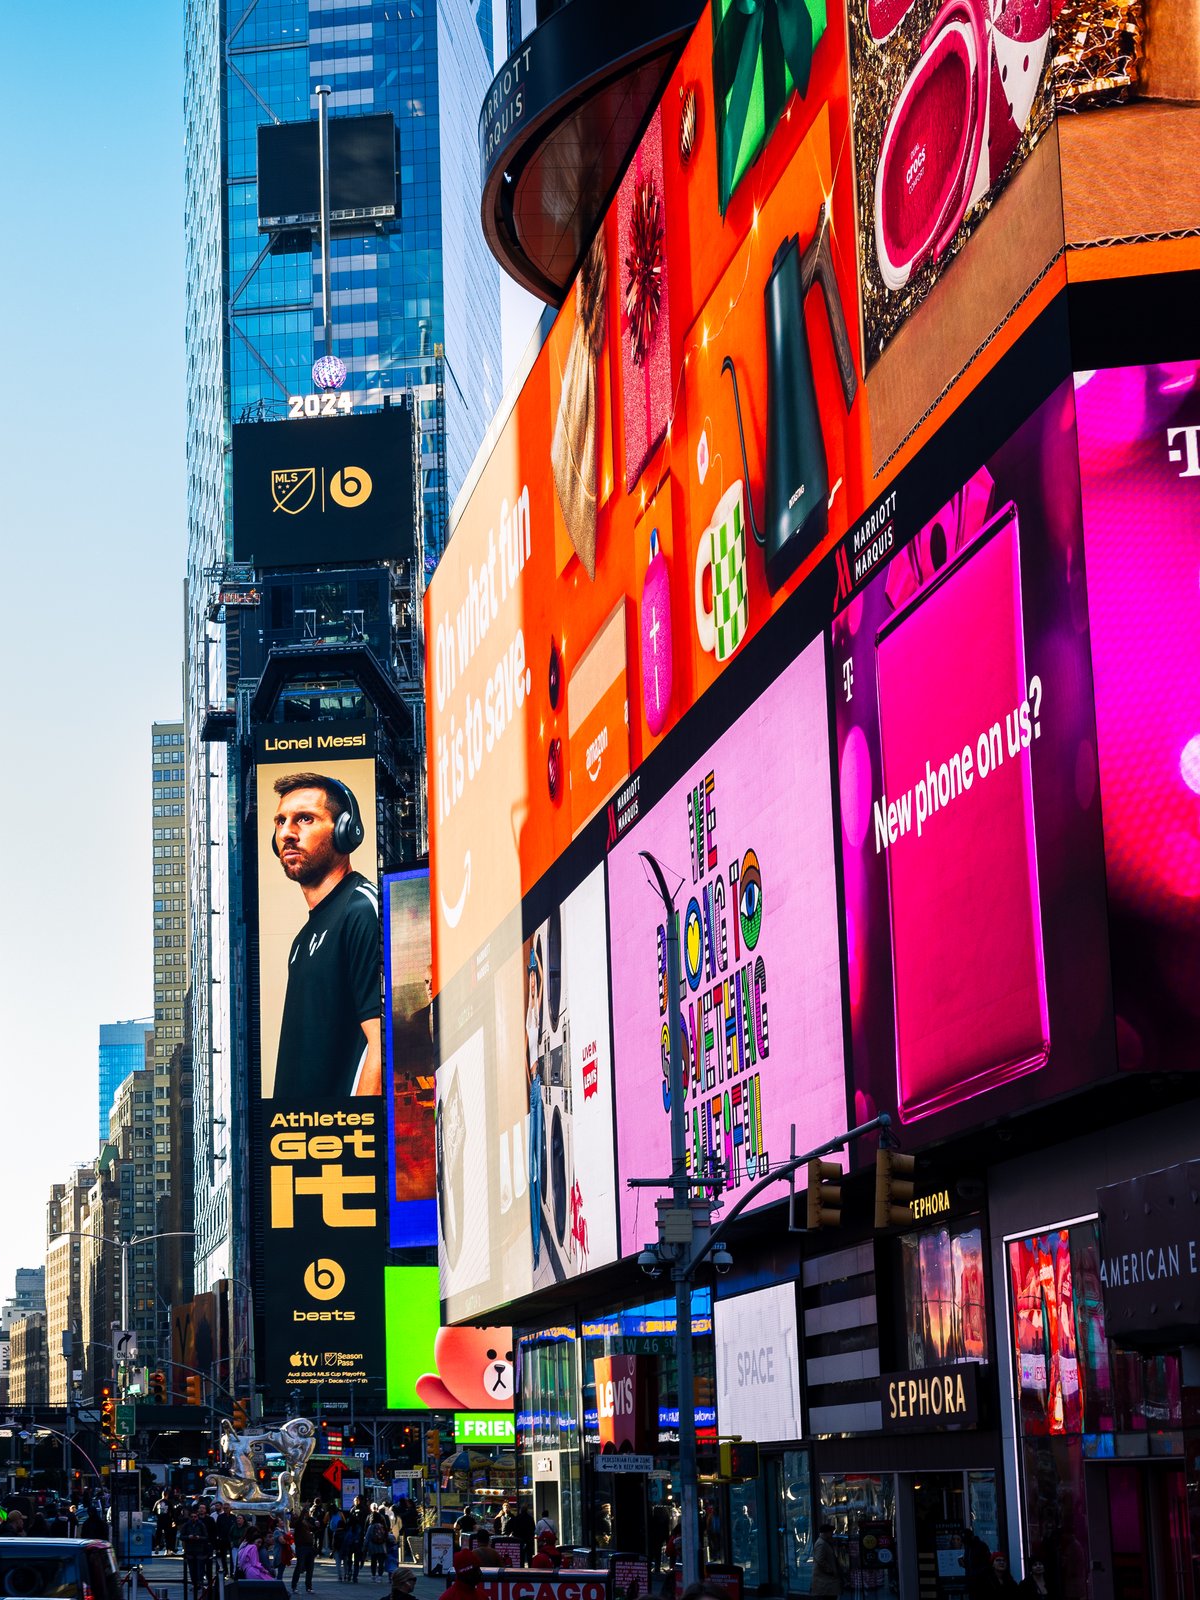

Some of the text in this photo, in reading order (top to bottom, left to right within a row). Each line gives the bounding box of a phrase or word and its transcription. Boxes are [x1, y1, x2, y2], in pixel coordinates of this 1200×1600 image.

[483, 47, 531, 133] ARRIOTT
[485, 93, 522, 161] ARQUIS
[906, 148, 925, 184] crocs
[288, 392, 353, 418] 2024
[275, 473, 298, 484] MLS
[853, 490, 897, 553] MARRIOTT
[855, 526, 893, 580] MARQUIS
[436, 485, 531, 712] Oh what fun
[265, 733, 366, 751] Lionel Messi
[437, 628, 531, 823] it is to save.
[585, 726, 608, 771] amazon
[875, 675, 1042, 853] New phone on us?
[617, 776, 640, 812] MARRIOTT
[618, 800, 639, 832] MARQUIS
[686, 769, 718, 885] WE
[656, 875, 728, 1017] BLONG
[270, 1111, 375, 1128] Athletes
[685, 1072, 769, 1200] AUTIFUL
[270, 1129, 375, 1160] Get
[270, 1164, 376, 1228] It
[910, 1190, 950, 1219] SEPHORA
[1101, 1244, 1180, 1288] AMERICAN
[293, 1309, 356, 1321] beats
[302, 1352, 363, 1366] tv Season
[626, 1340, 636, 1352] W
[643, 1338, 658, 1352] 46
[737, 1347, 774, 1387] SPACE
[890, 1374, 966, 1419] SEPHORA
[464, 1421, 515, 1436] FRIEN
[482, 1582, 605, 1600] HICAGO
